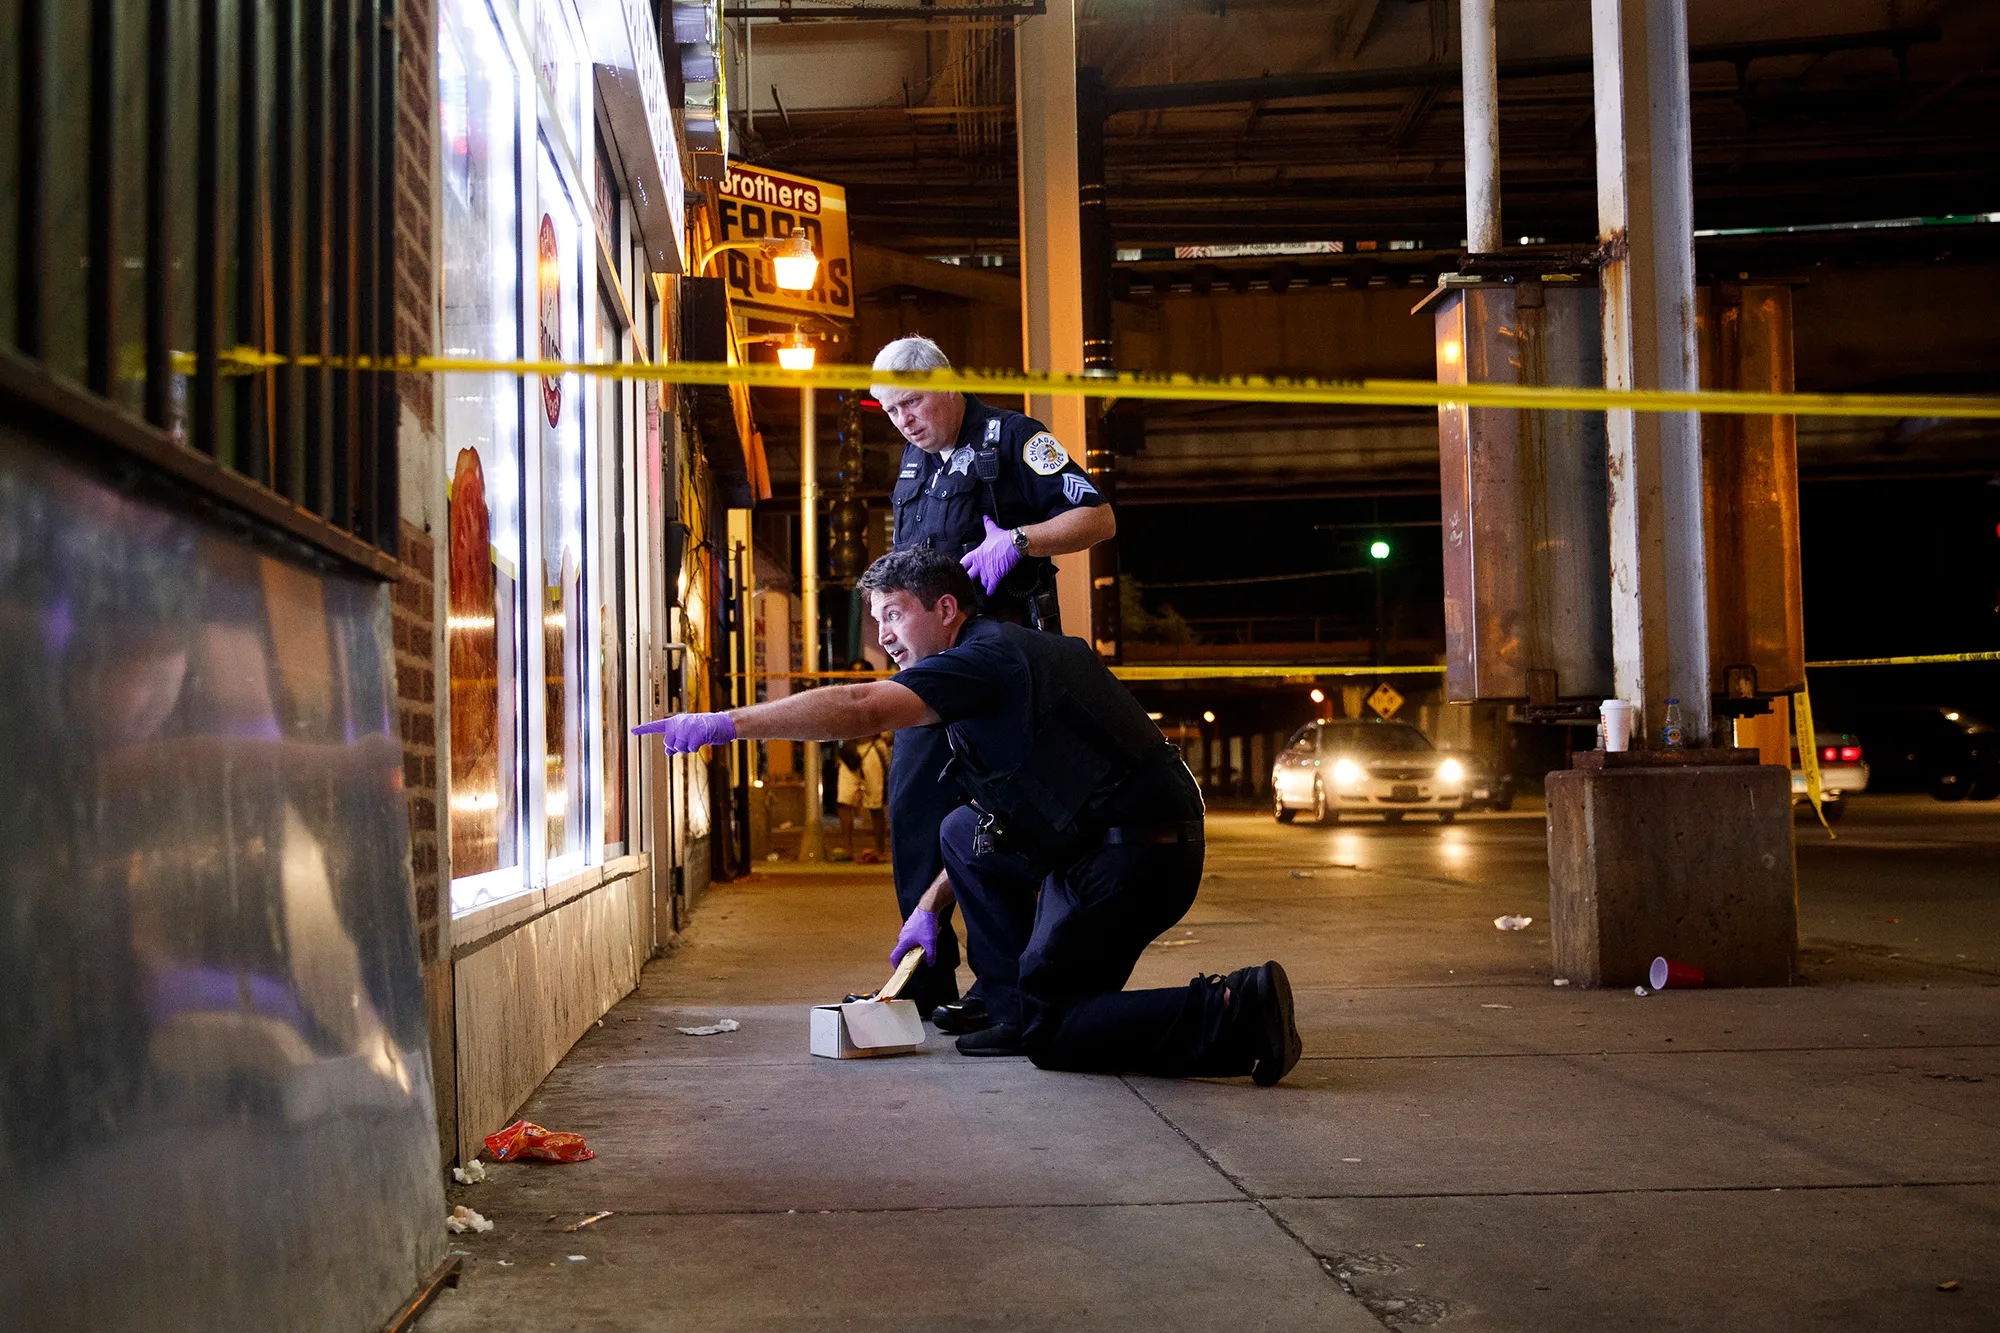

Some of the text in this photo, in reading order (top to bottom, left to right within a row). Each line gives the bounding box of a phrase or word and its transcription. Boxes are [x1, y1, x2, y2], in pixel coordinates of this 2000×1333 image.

[719, 168, 818, 213] Brothers
[719, 198, 824, 259] FOOD
[728, 248, 850, 307] QUS
[1029, 437, 1055, 462] CHICAGO
[1042, 452, 1064, 470] POLICE
